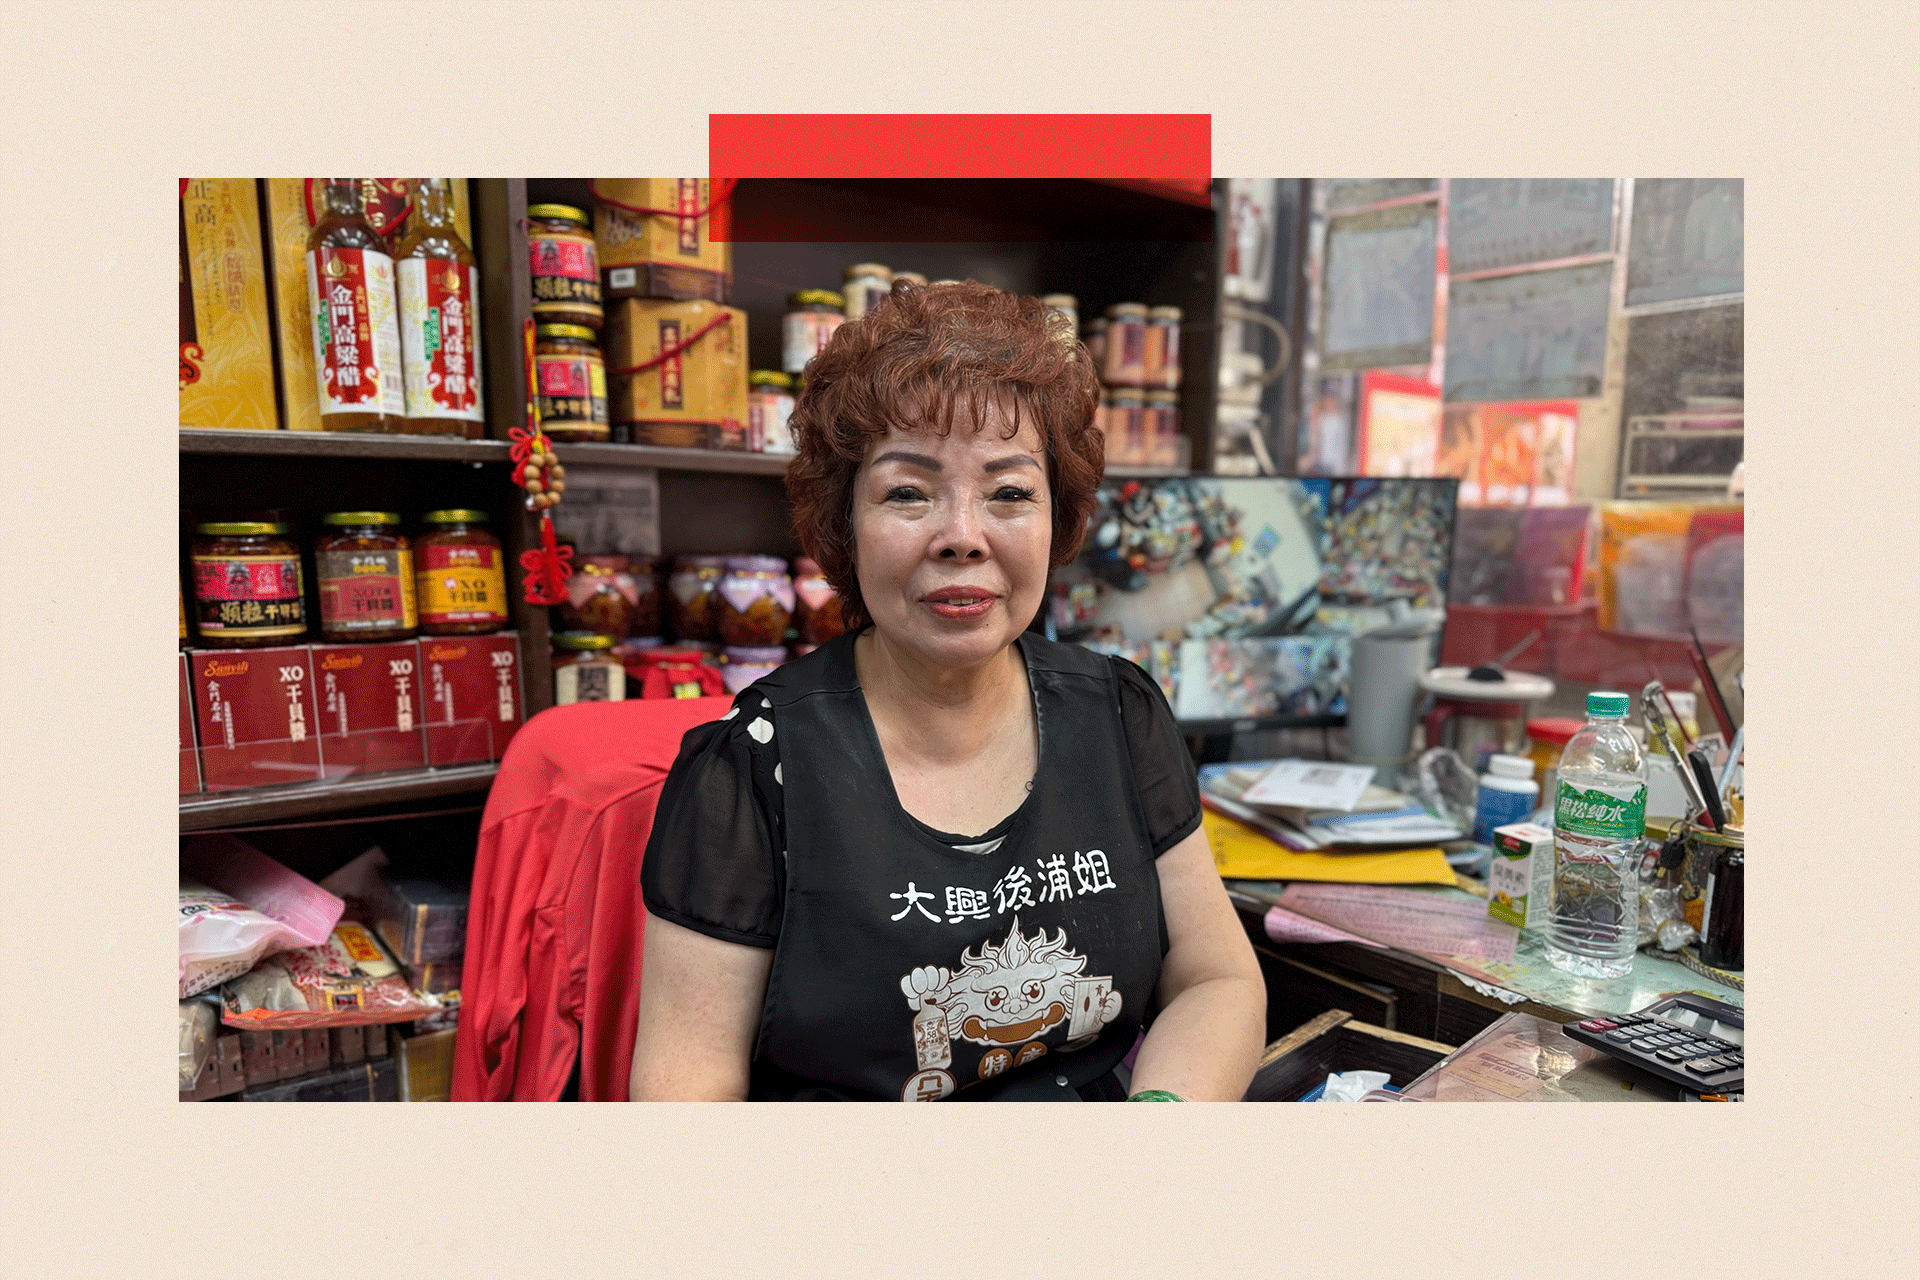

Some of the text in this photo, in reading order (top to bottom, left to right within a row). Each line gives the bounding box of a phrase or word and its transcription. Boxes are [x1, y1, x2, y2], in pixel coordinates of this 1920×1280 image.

[389, 659, 413, 675] XO
[491, 651, 514, 667] XO
[279, 665, 304, 682] XO
[889, 849, 1117, 924] 大興後浦姐
